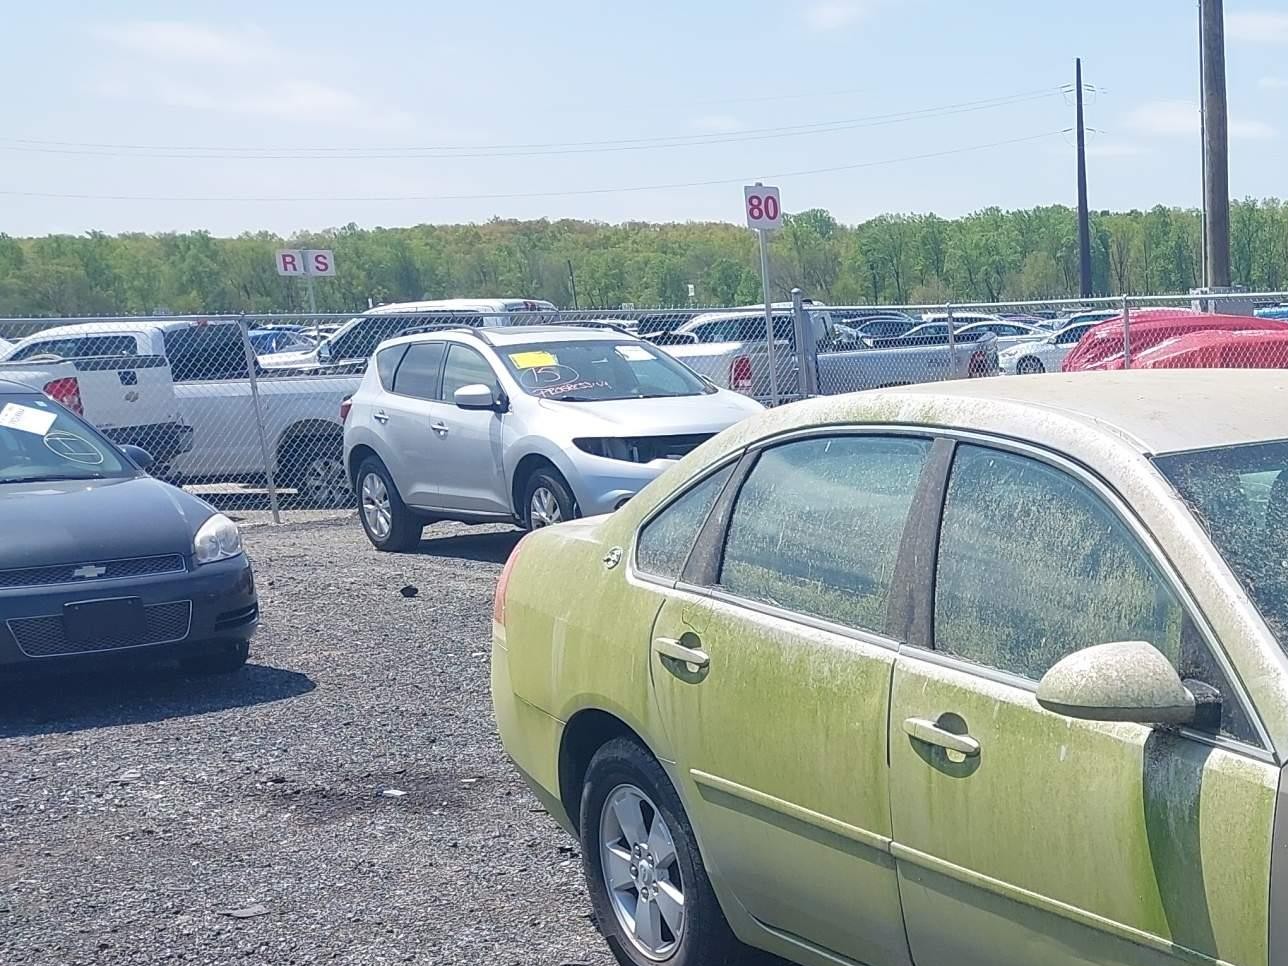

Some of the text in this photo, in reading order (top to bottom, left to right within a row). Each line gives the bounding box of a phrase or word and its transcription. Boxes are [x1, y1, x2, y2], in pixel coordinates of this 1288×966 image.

[748, 195, 779, 221] 80
[281, 254, 298, 272] R
[314, 254, 330, 272] S
[532, 366, 561, 383] 15
